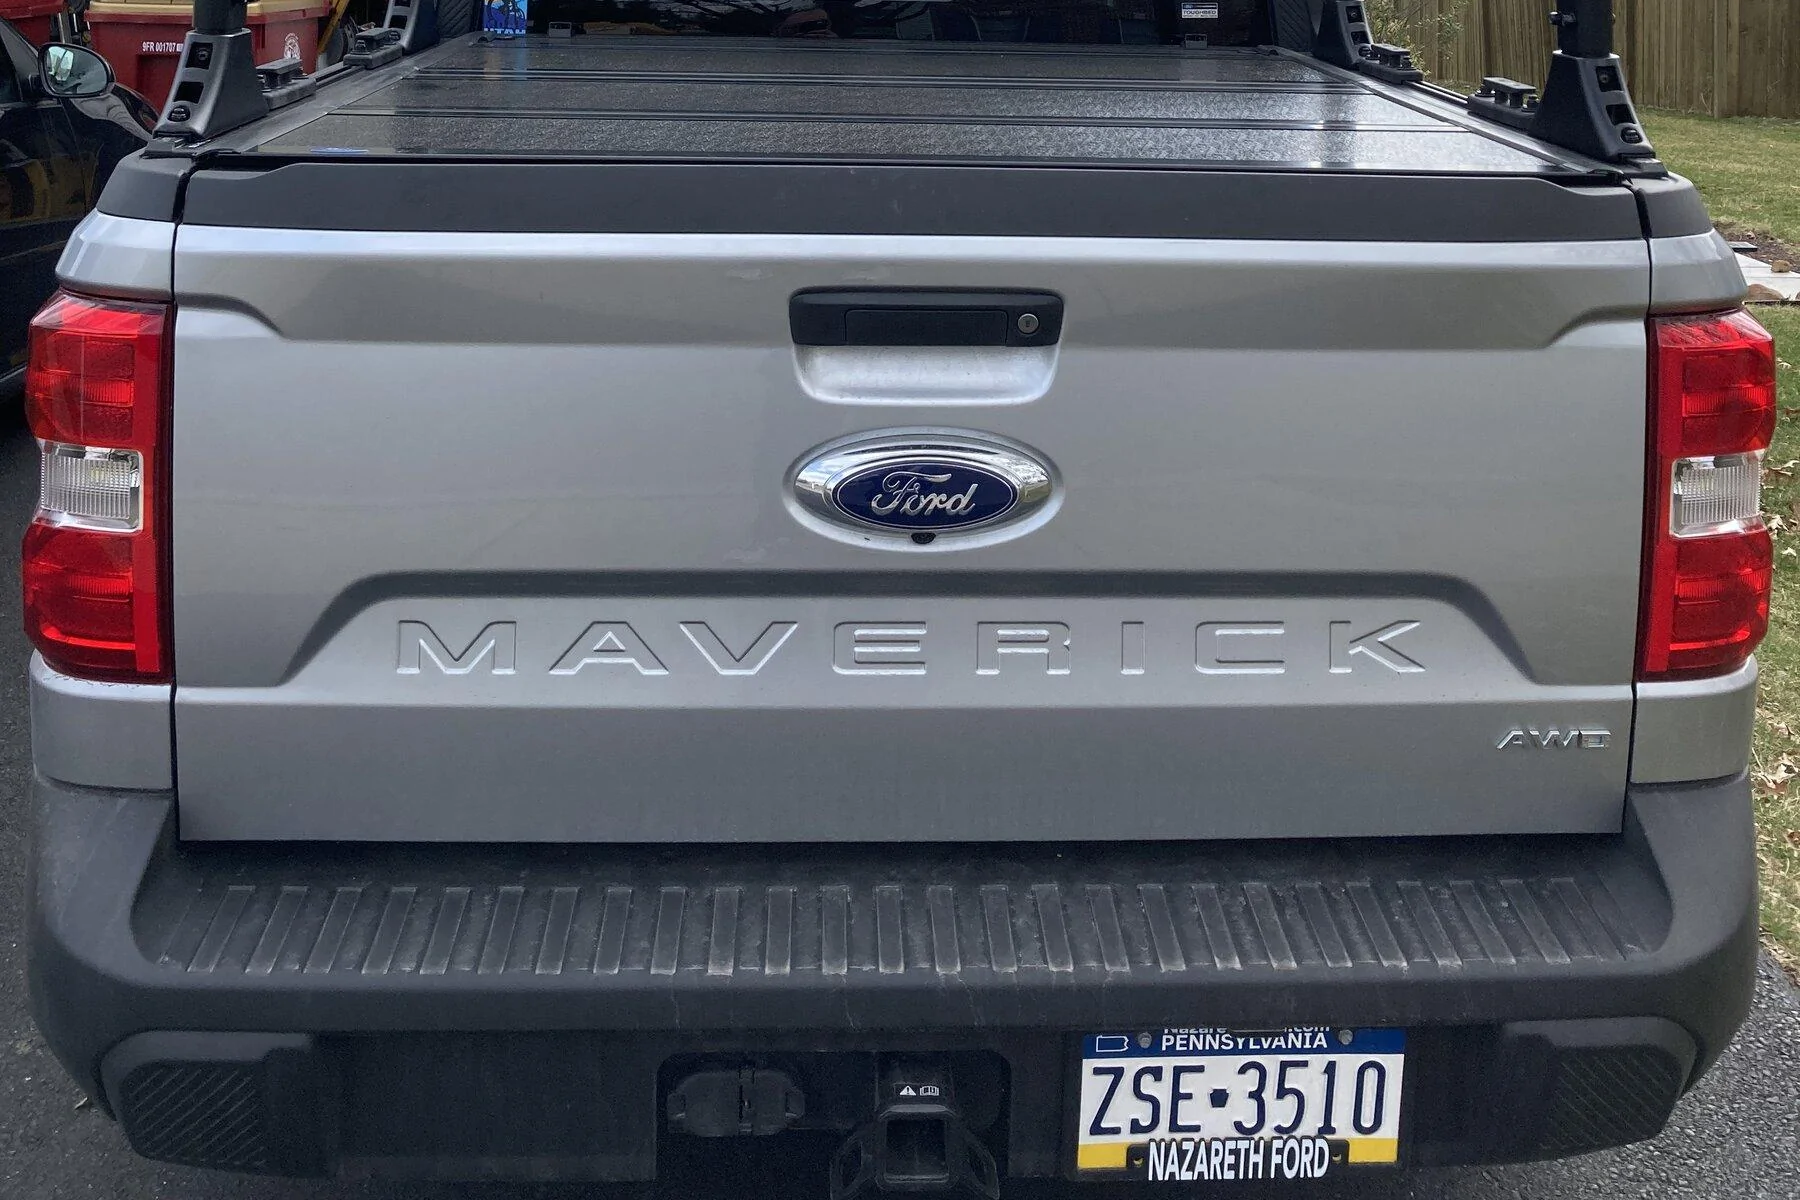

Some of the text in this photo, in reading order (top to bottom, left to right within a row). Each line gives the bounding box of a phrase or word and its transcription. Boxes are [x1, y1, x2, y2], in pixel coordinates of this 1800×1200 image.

[871, 471, 978, 515] Ford
[397, 620, 1426, 675] MAVERICK
[1496, 730, 1612, 750] AWD
[1161, 1032, 1328, 1051] PENNSYLVANIA
[1148, 1138, 1330, 1181] NAZARETH FORD
